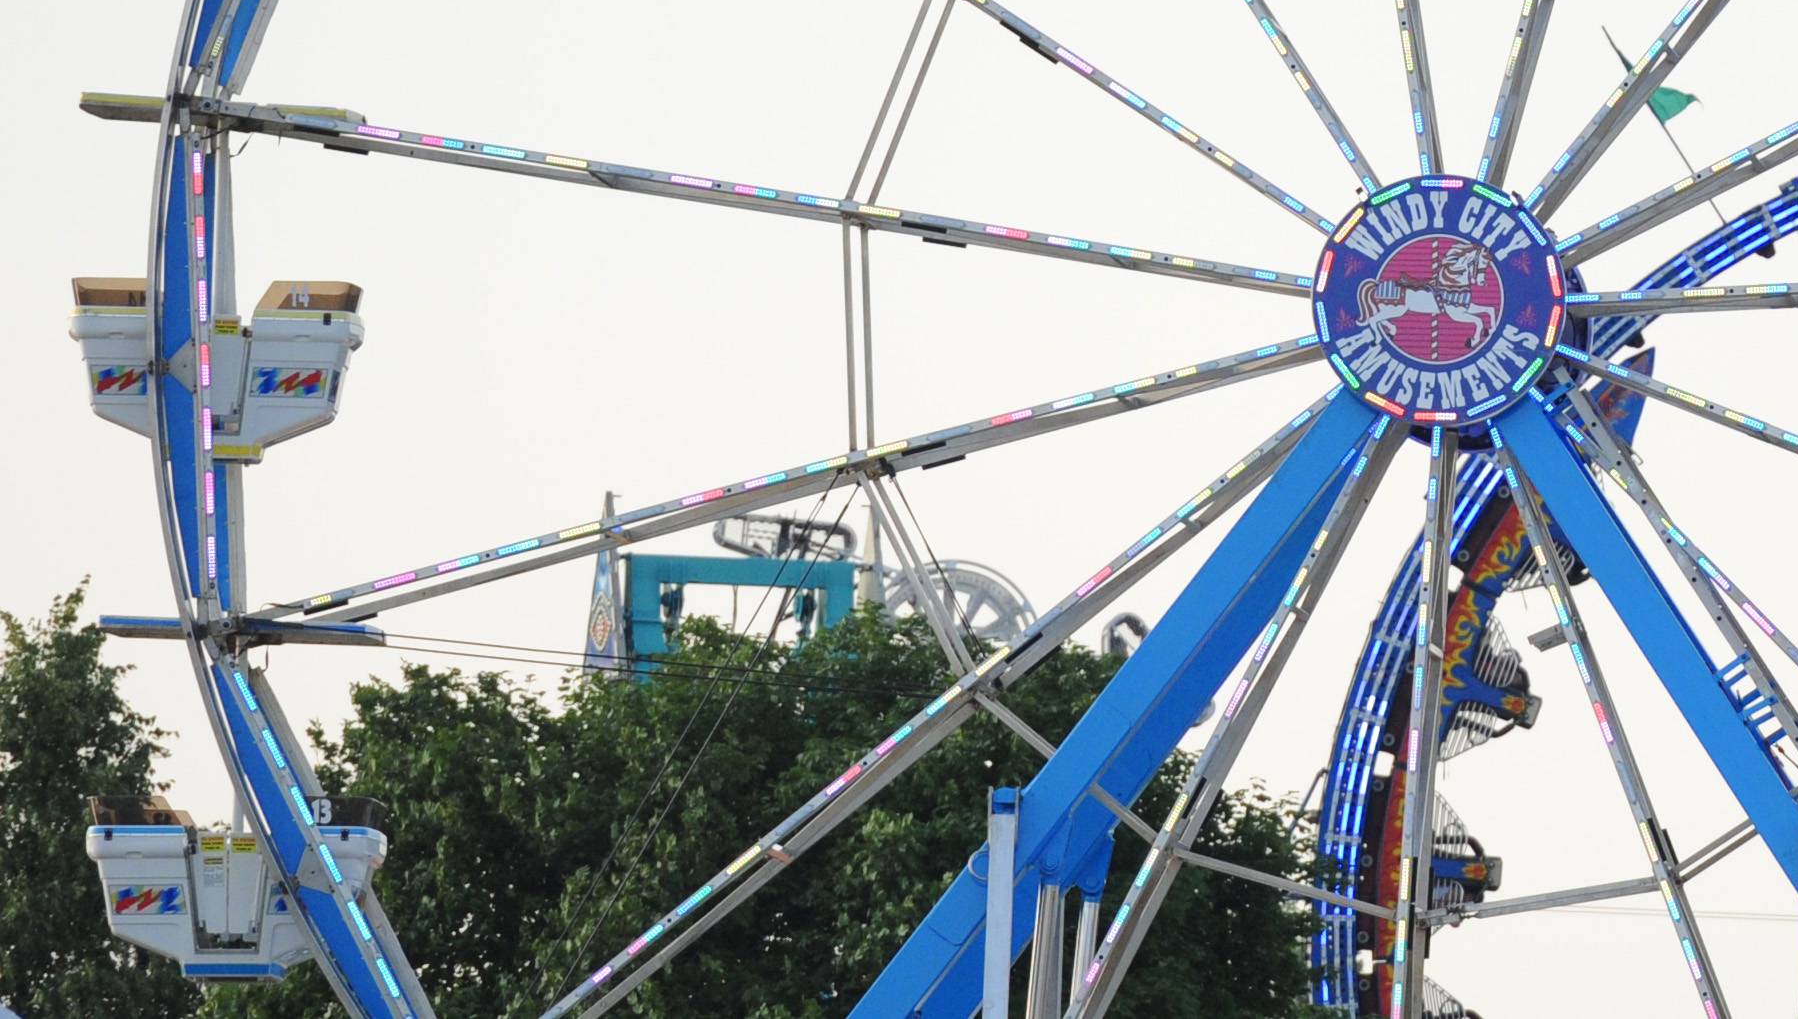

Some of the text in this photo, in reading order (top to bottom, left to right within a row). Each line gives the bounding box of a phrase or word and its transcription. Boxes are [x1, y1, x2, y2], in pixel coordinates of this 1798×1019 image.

[1344, 190, 1532, 262] WINDY CITY
[1335, 324, 1541, 410] AMUSEMENTS
[311, 798, 332, 825] 13
